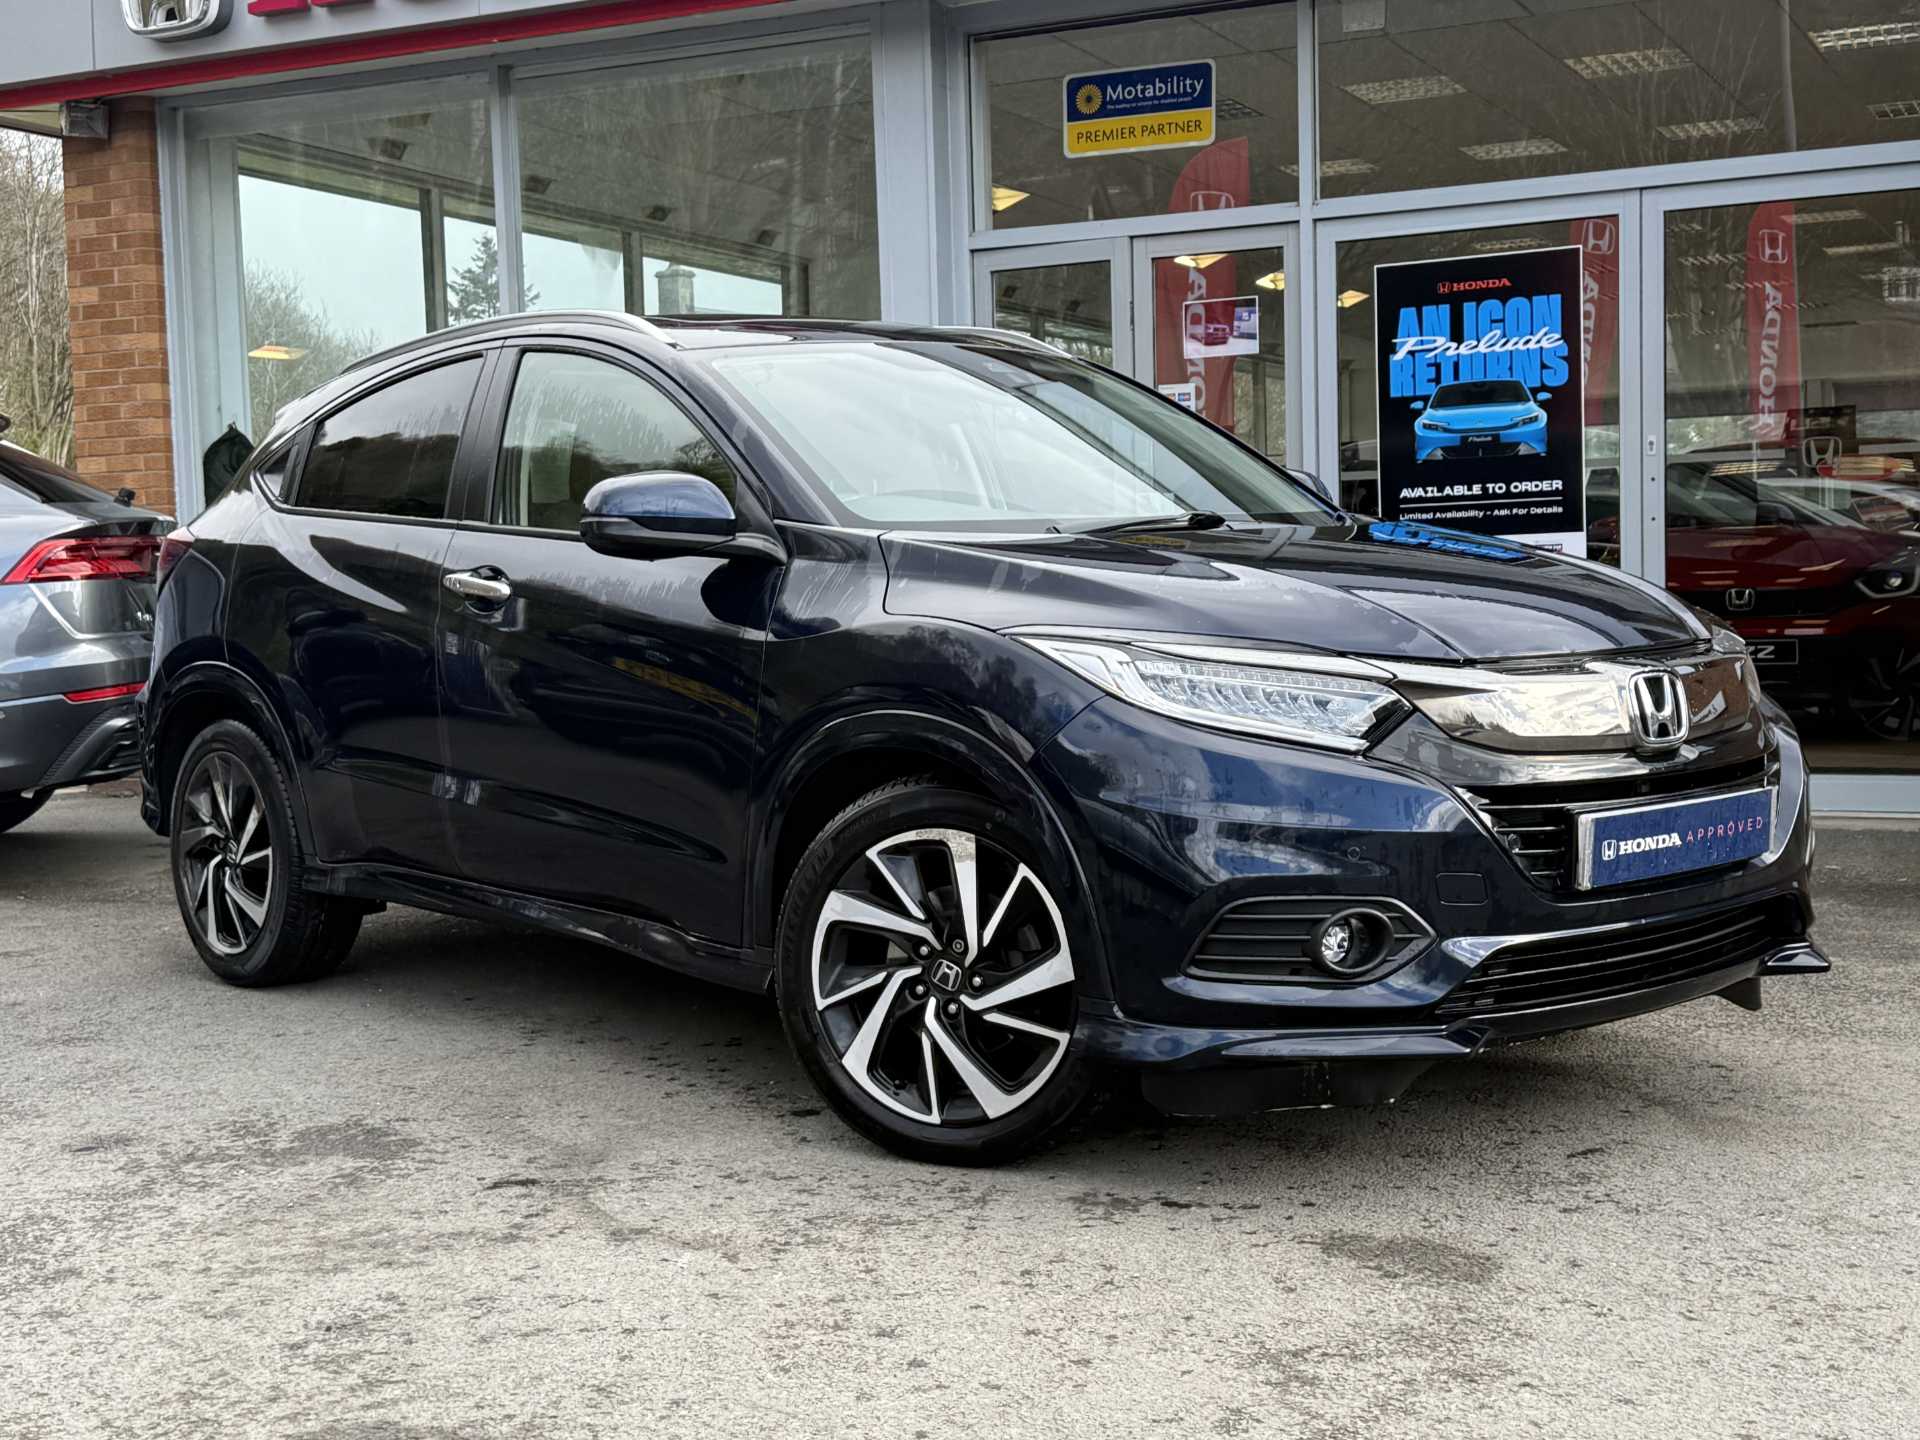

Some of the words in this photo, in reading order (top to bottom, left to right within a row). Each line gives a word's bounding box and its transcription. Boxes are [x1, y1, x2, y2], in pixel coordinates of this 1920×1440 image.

[1106, 75, 1204, 102] Motability
[1076, 127, 1137, 144] PREMIER
[1141, 120, 1203, 137] PARTNER
[1453, 278, 1512, 291] HONDA
[1395, 304, 1450, 351] AN
[1463, 294, 1561, 343] ICON
[1391, 326, 1564, 360] Prelude
[1389, 343, 1569, 398] RETURNS
[1399, 484, 1483, 499] AVAILABLE
[1487, 483, 1506, 494] TO
[1510, 480, 1563, 493] ORDER
[1399, 510, 1433, 521] Limited
[1435, 509, 1485, 520] Availability
[1493, 508, 1511, 516] Ask
[1513, 507, 1528, 515] For
[1530, 505, 1563, 515] Details
[1618, 832, 1682, 855] HONDA
[1686, 816, 1763, 843] APPROVED
